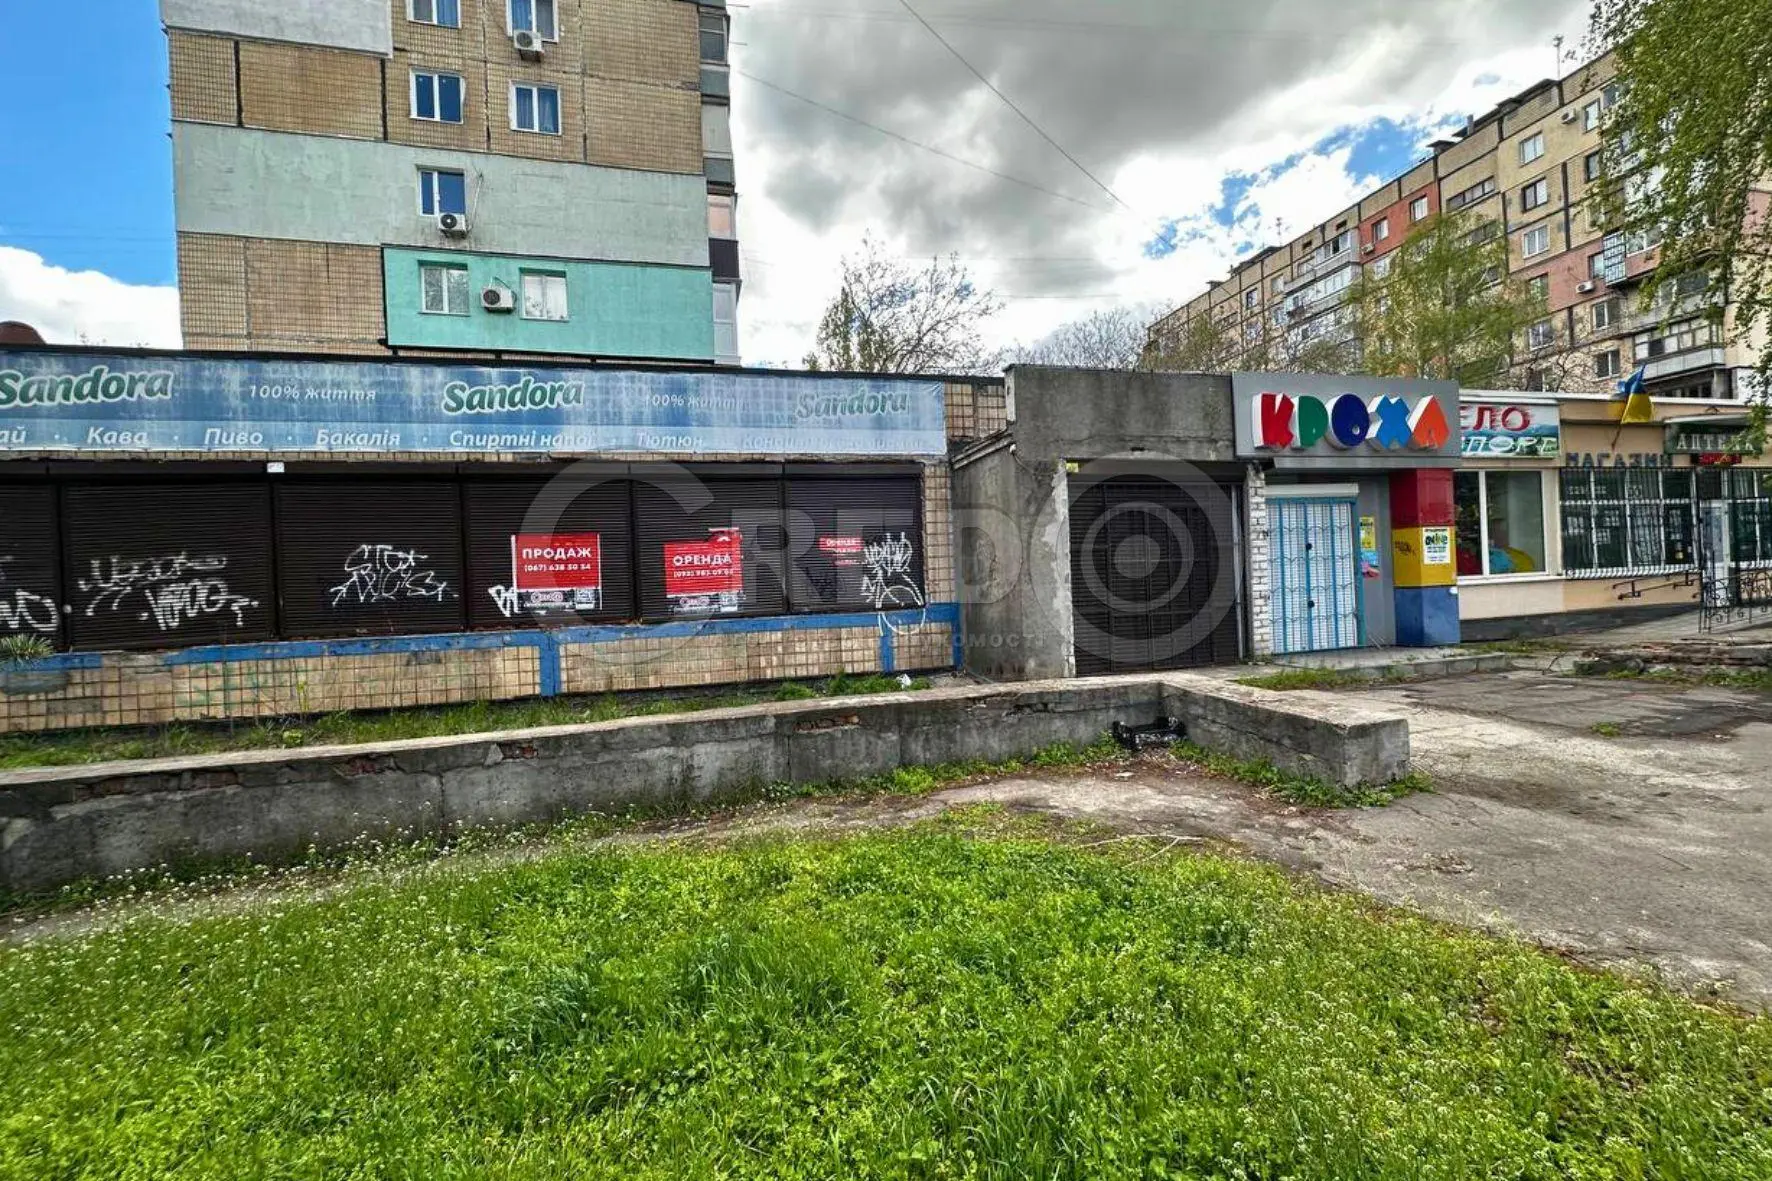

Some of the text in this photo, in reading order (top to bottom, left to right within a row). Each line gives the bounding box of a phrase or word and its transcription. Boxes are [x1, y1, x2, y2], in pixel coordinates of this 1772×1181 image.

[0, 366, 173, 409] Sandora
[250, 386, 377, 401] 100% життя
[442, 376, 585, 415] Sandora
[795, 384, 911, 420] Sandora
[1252, 393, 1449, 451] КРОХА
[87, 427, 149, 445] Кава
[204, 428, 263, 445] Пиво
[316, 429, 401, 446] Бакалія
[450, 430, 535, 449] Спиртні
[637, 431, 702, 449] Тютюн
[1565, 452, 1673, 469] МАГАЗИН
[522, 547, 591, 560] ПРОДАЖ
[673, 552, 732, 567] ОРЕНДА
